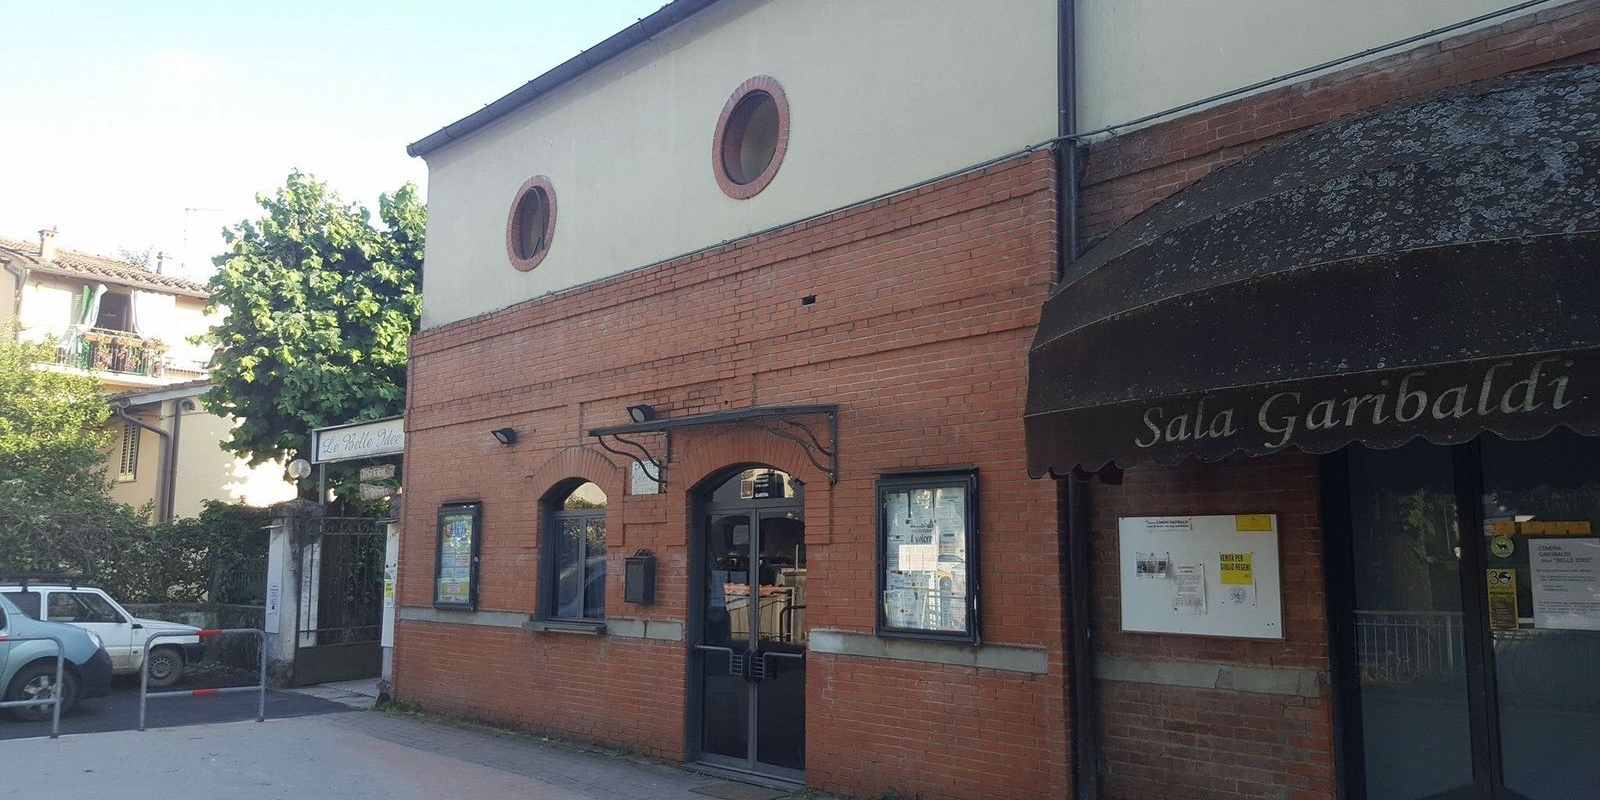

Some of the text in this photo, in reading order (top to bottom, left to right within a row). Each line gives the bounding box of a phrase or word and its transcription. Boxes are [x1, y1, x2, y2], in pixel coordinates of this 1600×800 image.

[1134, 357, 1574, 448] Sala Garibaldi
[322, 436, 339, 453] Le
[343, 431, 373, 451] Belle
